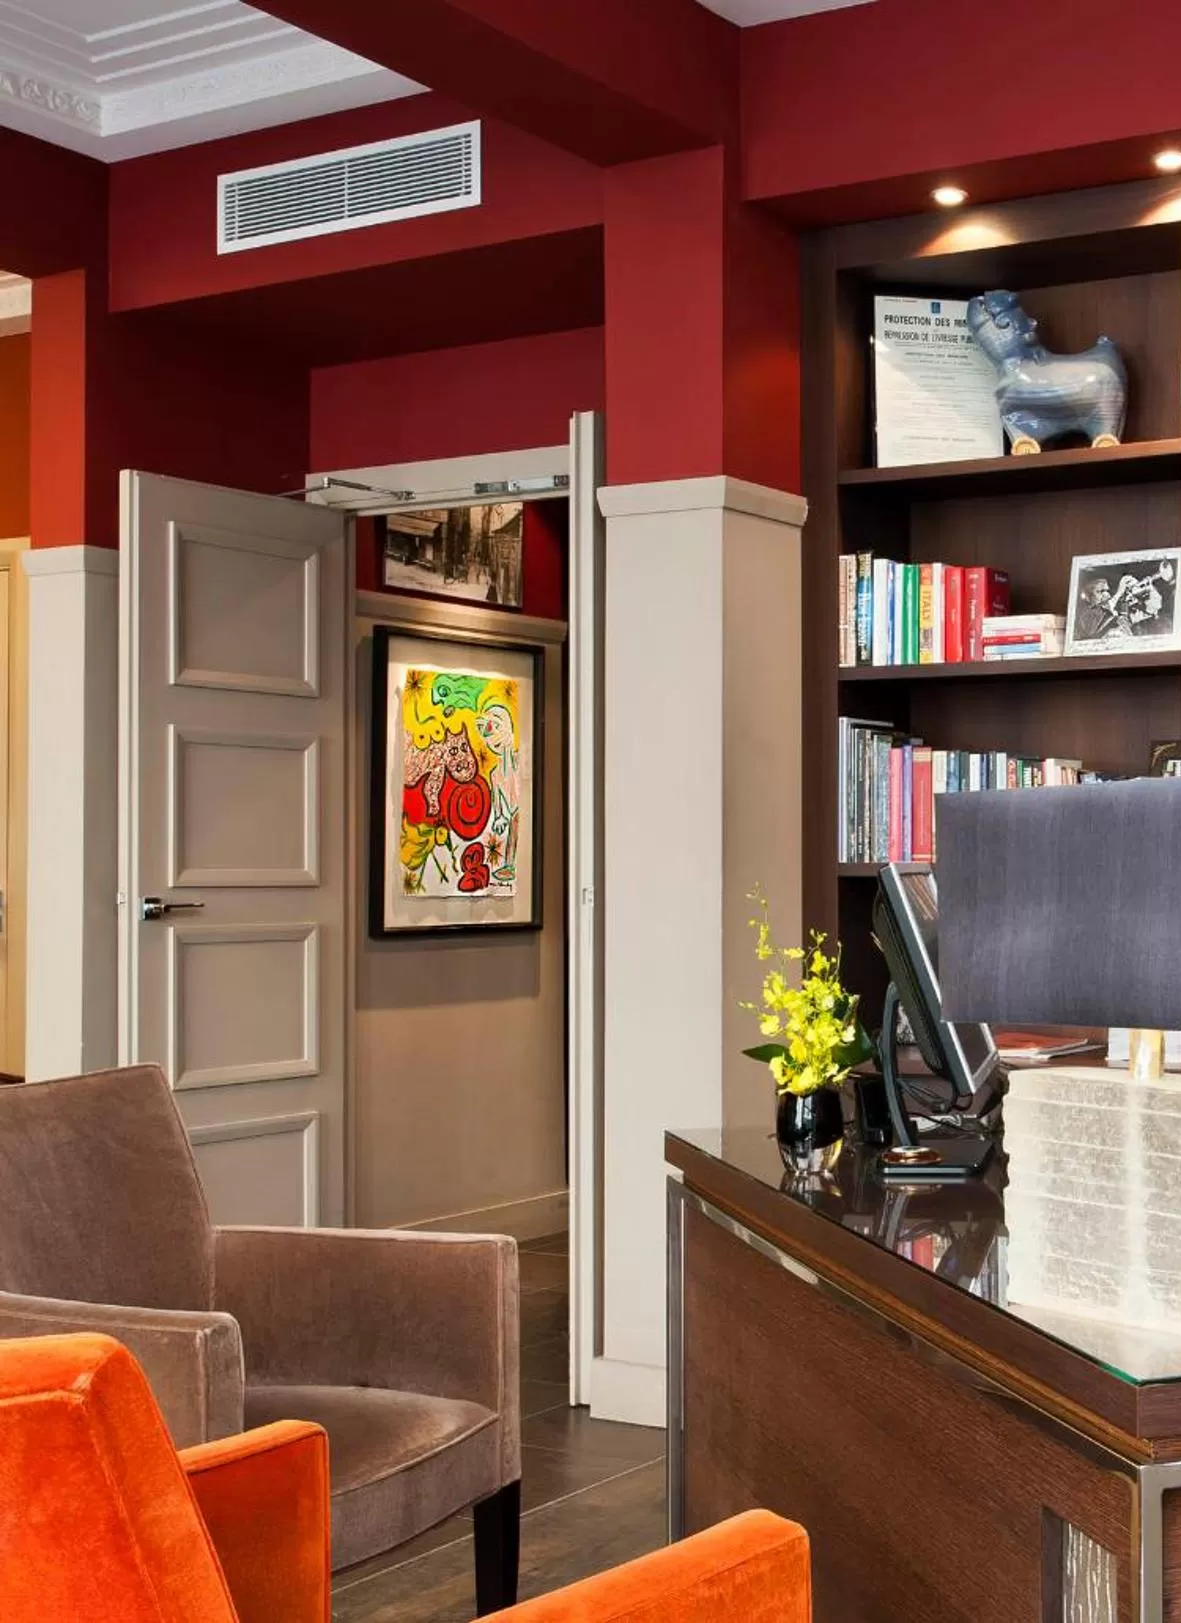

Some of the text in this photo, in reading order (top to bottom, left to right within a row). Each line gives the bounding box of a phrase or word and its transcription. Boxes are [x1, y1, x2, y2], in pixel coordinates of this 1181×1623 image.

[884, 314, 931, 326] PROTECTION
[935, 317, 951, 327] DES
[923, 591, 931, 620] ITALY
